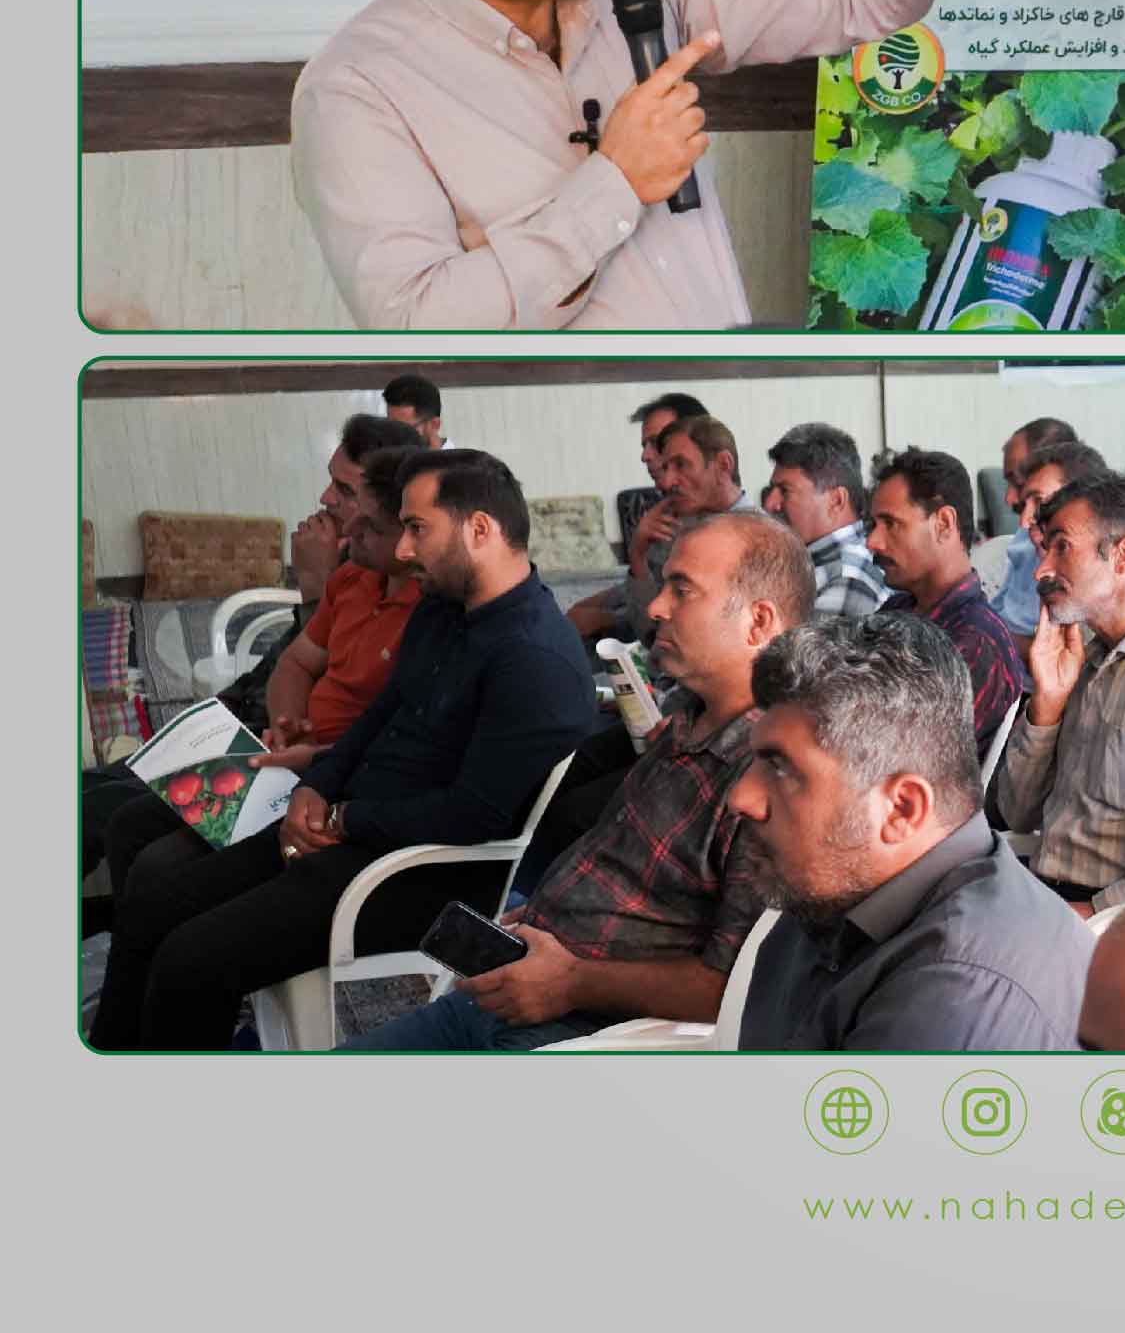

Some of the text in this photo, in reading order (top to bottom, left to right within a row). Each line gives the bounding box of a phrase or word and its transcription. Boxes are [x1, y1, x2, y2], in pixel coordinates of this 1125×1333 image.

[999, 11, 1008, 26] و
[1012, 6, 1055, 26] خاکزاد
[1059, 6, 1089, 26] های
[968, 39, 1001, 59] گیاه
[1003, 39, 1050, 57] عملکرد
[1055, 39, 1107, 59] افزایش
[1111, 44, 1119, 57] و
[872, 90, 898, 107] ZGB
